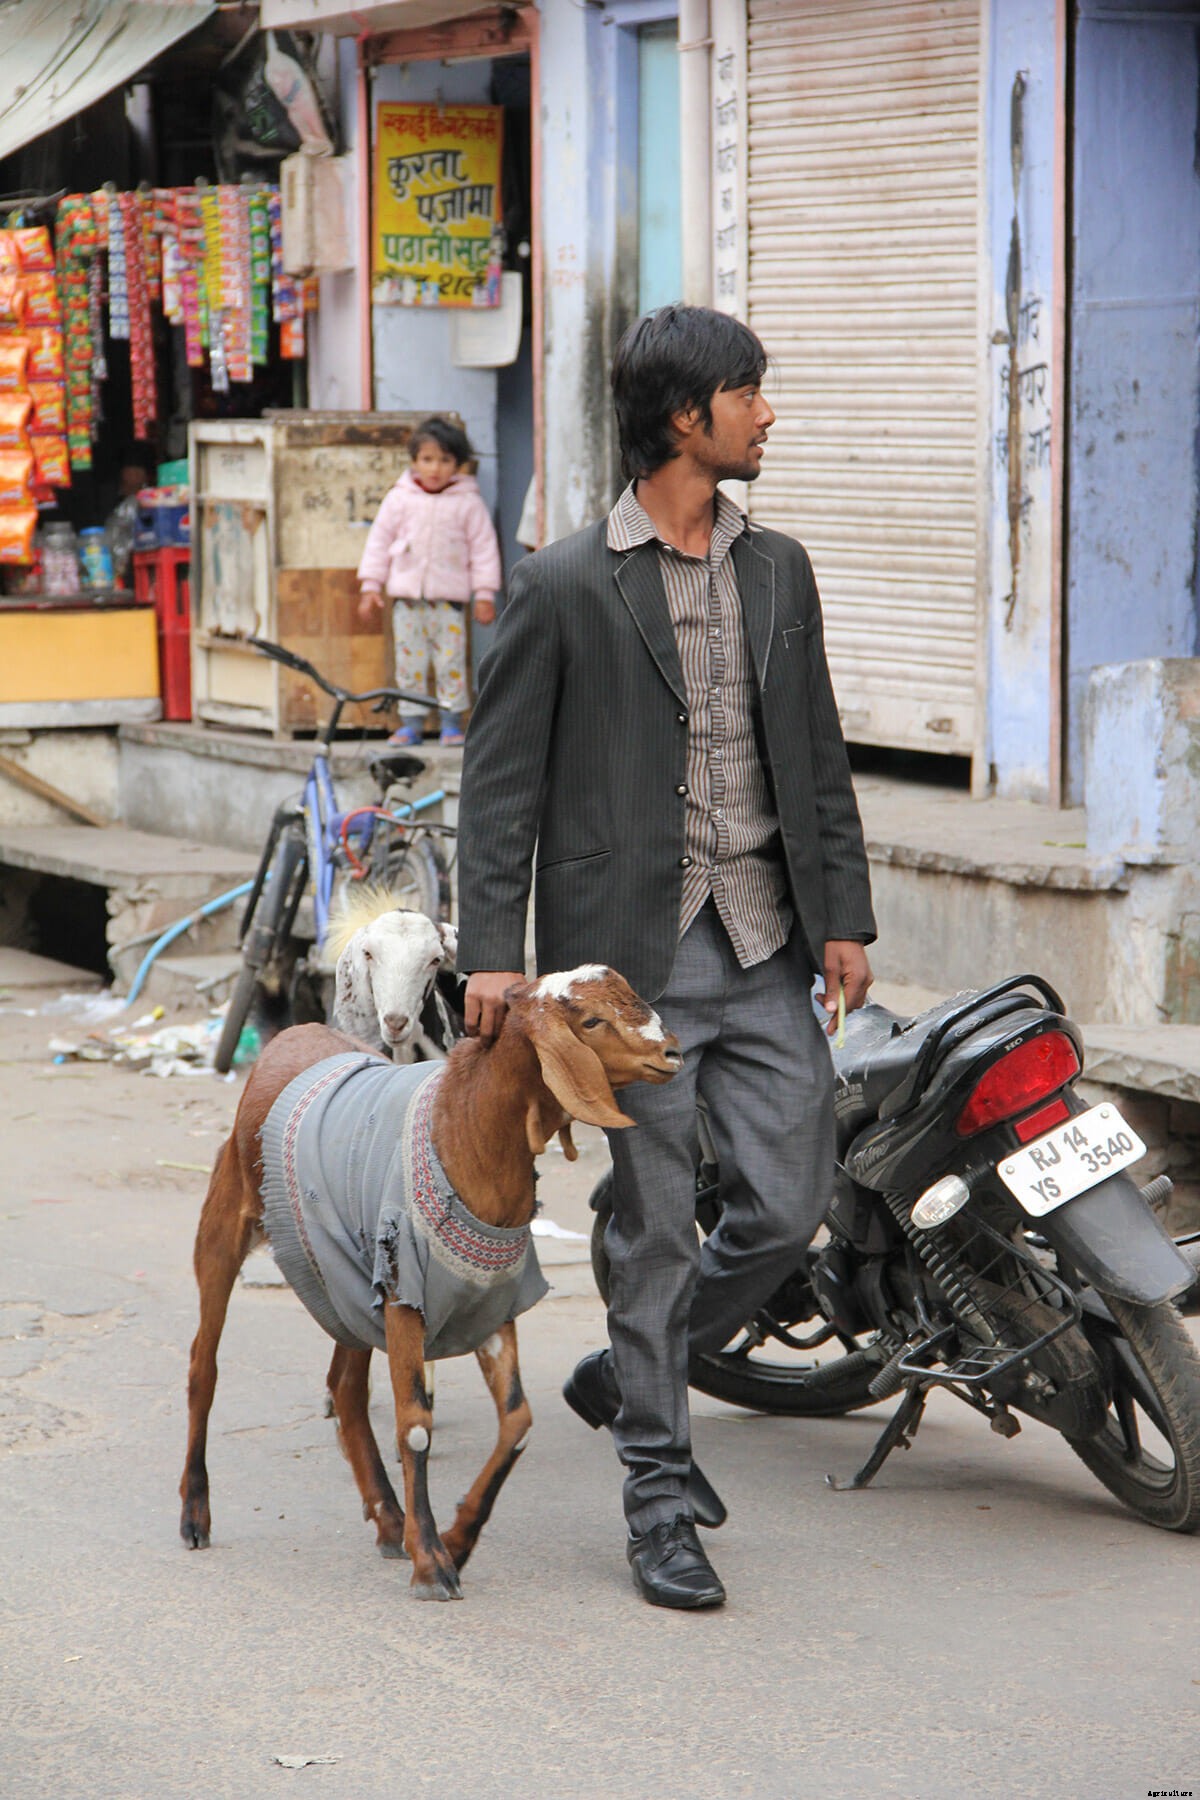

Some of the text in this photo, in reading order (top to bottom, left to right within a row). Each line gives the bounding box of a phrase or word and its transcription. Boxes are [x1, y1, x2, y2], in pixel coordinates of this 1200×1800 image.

[387, 149, 469, 198] कुरता
[416, 184, 493, 223] पजामा
[1028, 1125, 1088, 1172] RJ 14
[1081, 1131, 1133, 1174] 3540
[1030, 1177, 1062, 1203] YS
